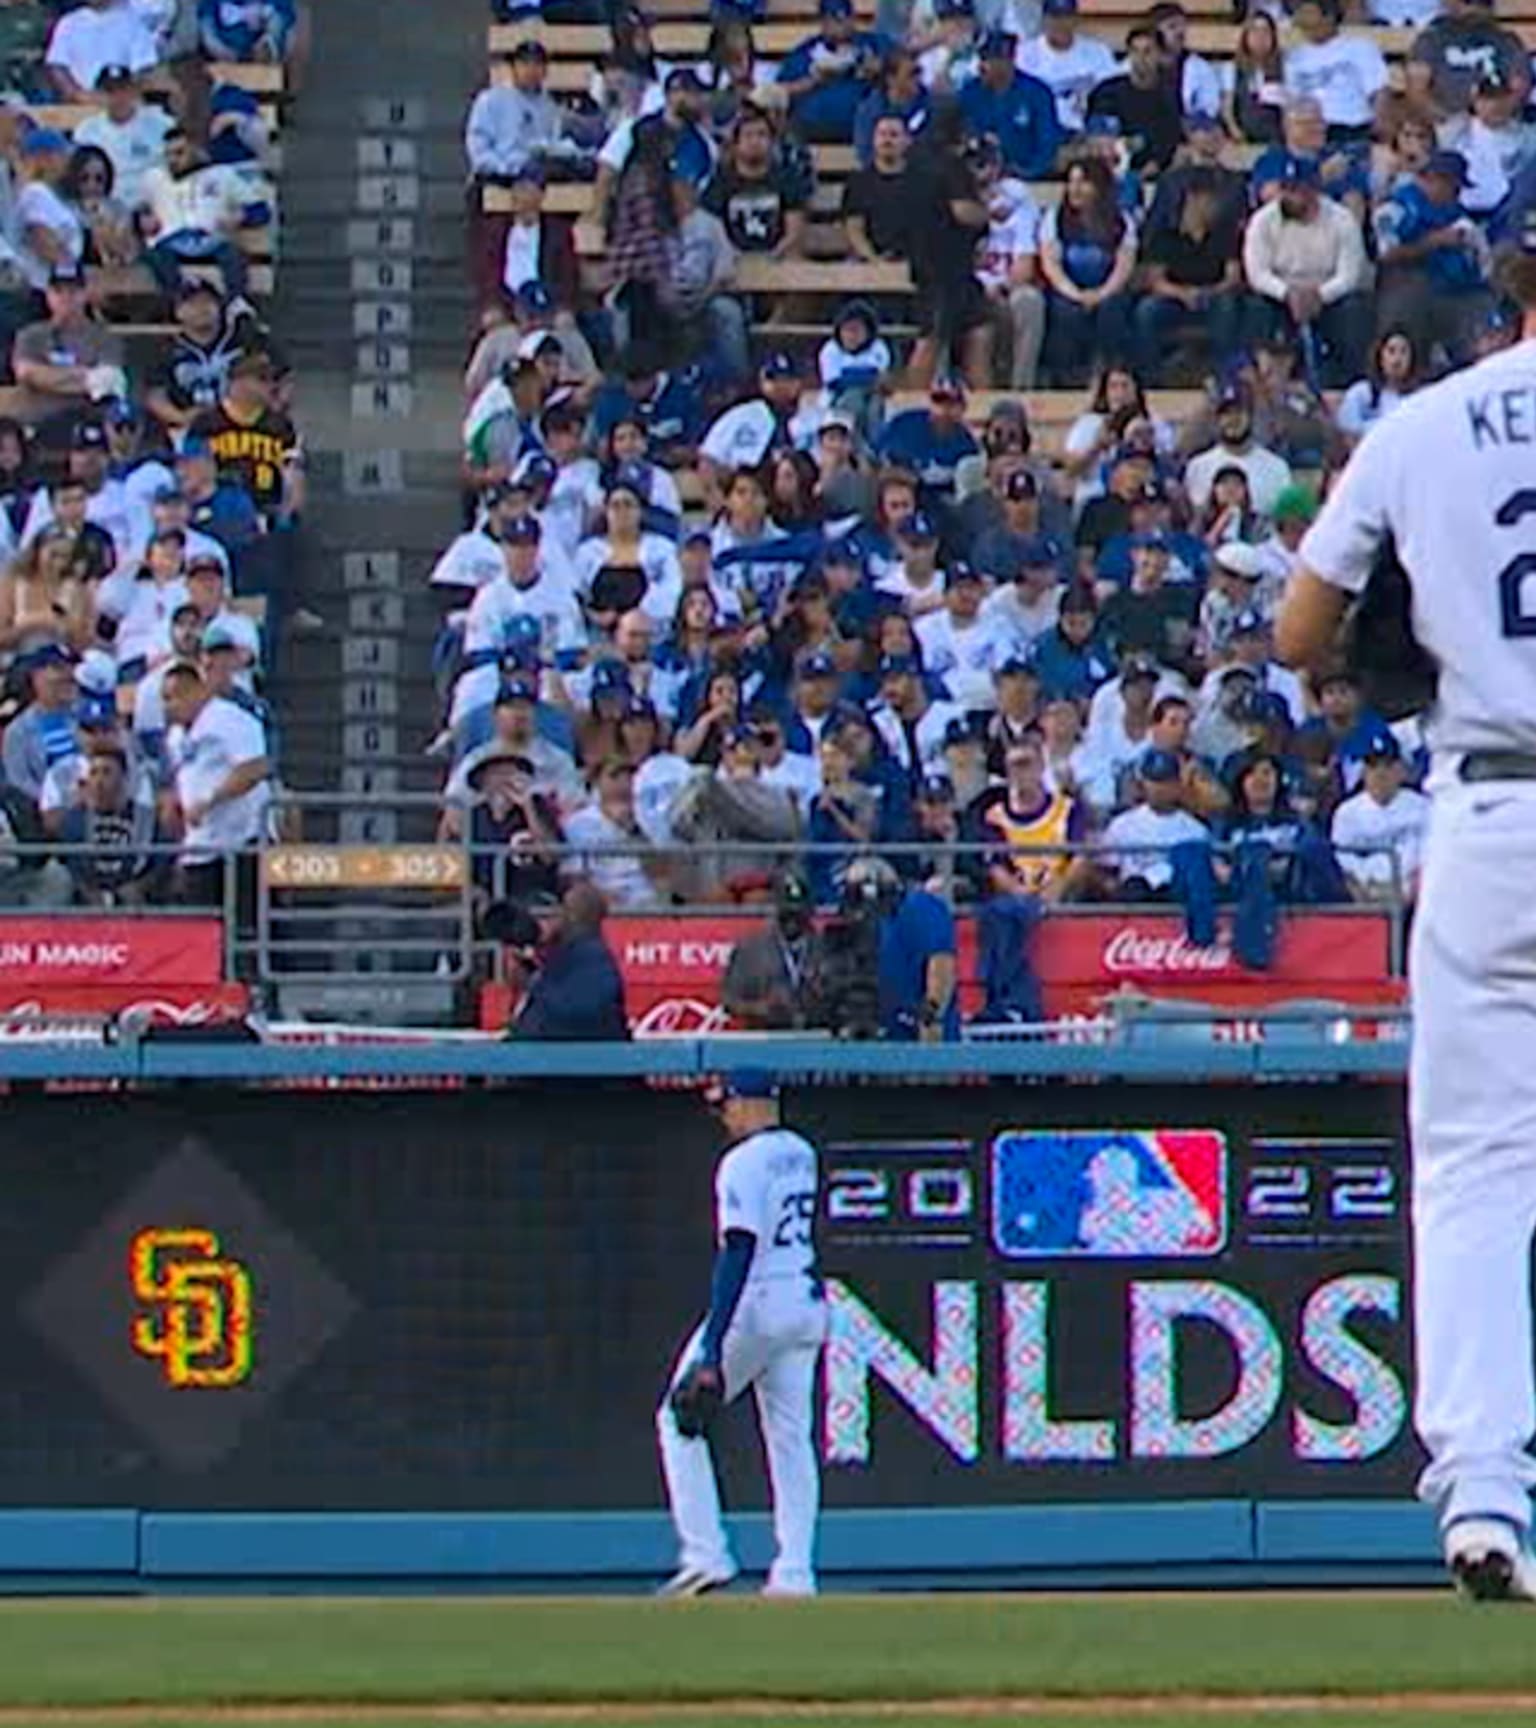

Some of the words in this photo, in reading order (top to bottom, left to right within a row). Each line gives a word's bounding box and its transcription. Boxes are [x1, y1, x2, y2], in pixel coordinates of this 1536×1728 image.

[37, 943, 129, 966] MAGIC
[625, 942, 671, 966] HIT
[828, 1167, 973, 1219] 20
[1247, 1166, 1396, 1216] 22
[128, 1226, 252, 1386] SD
[823, 1275, 1406, 1462] NLDS
